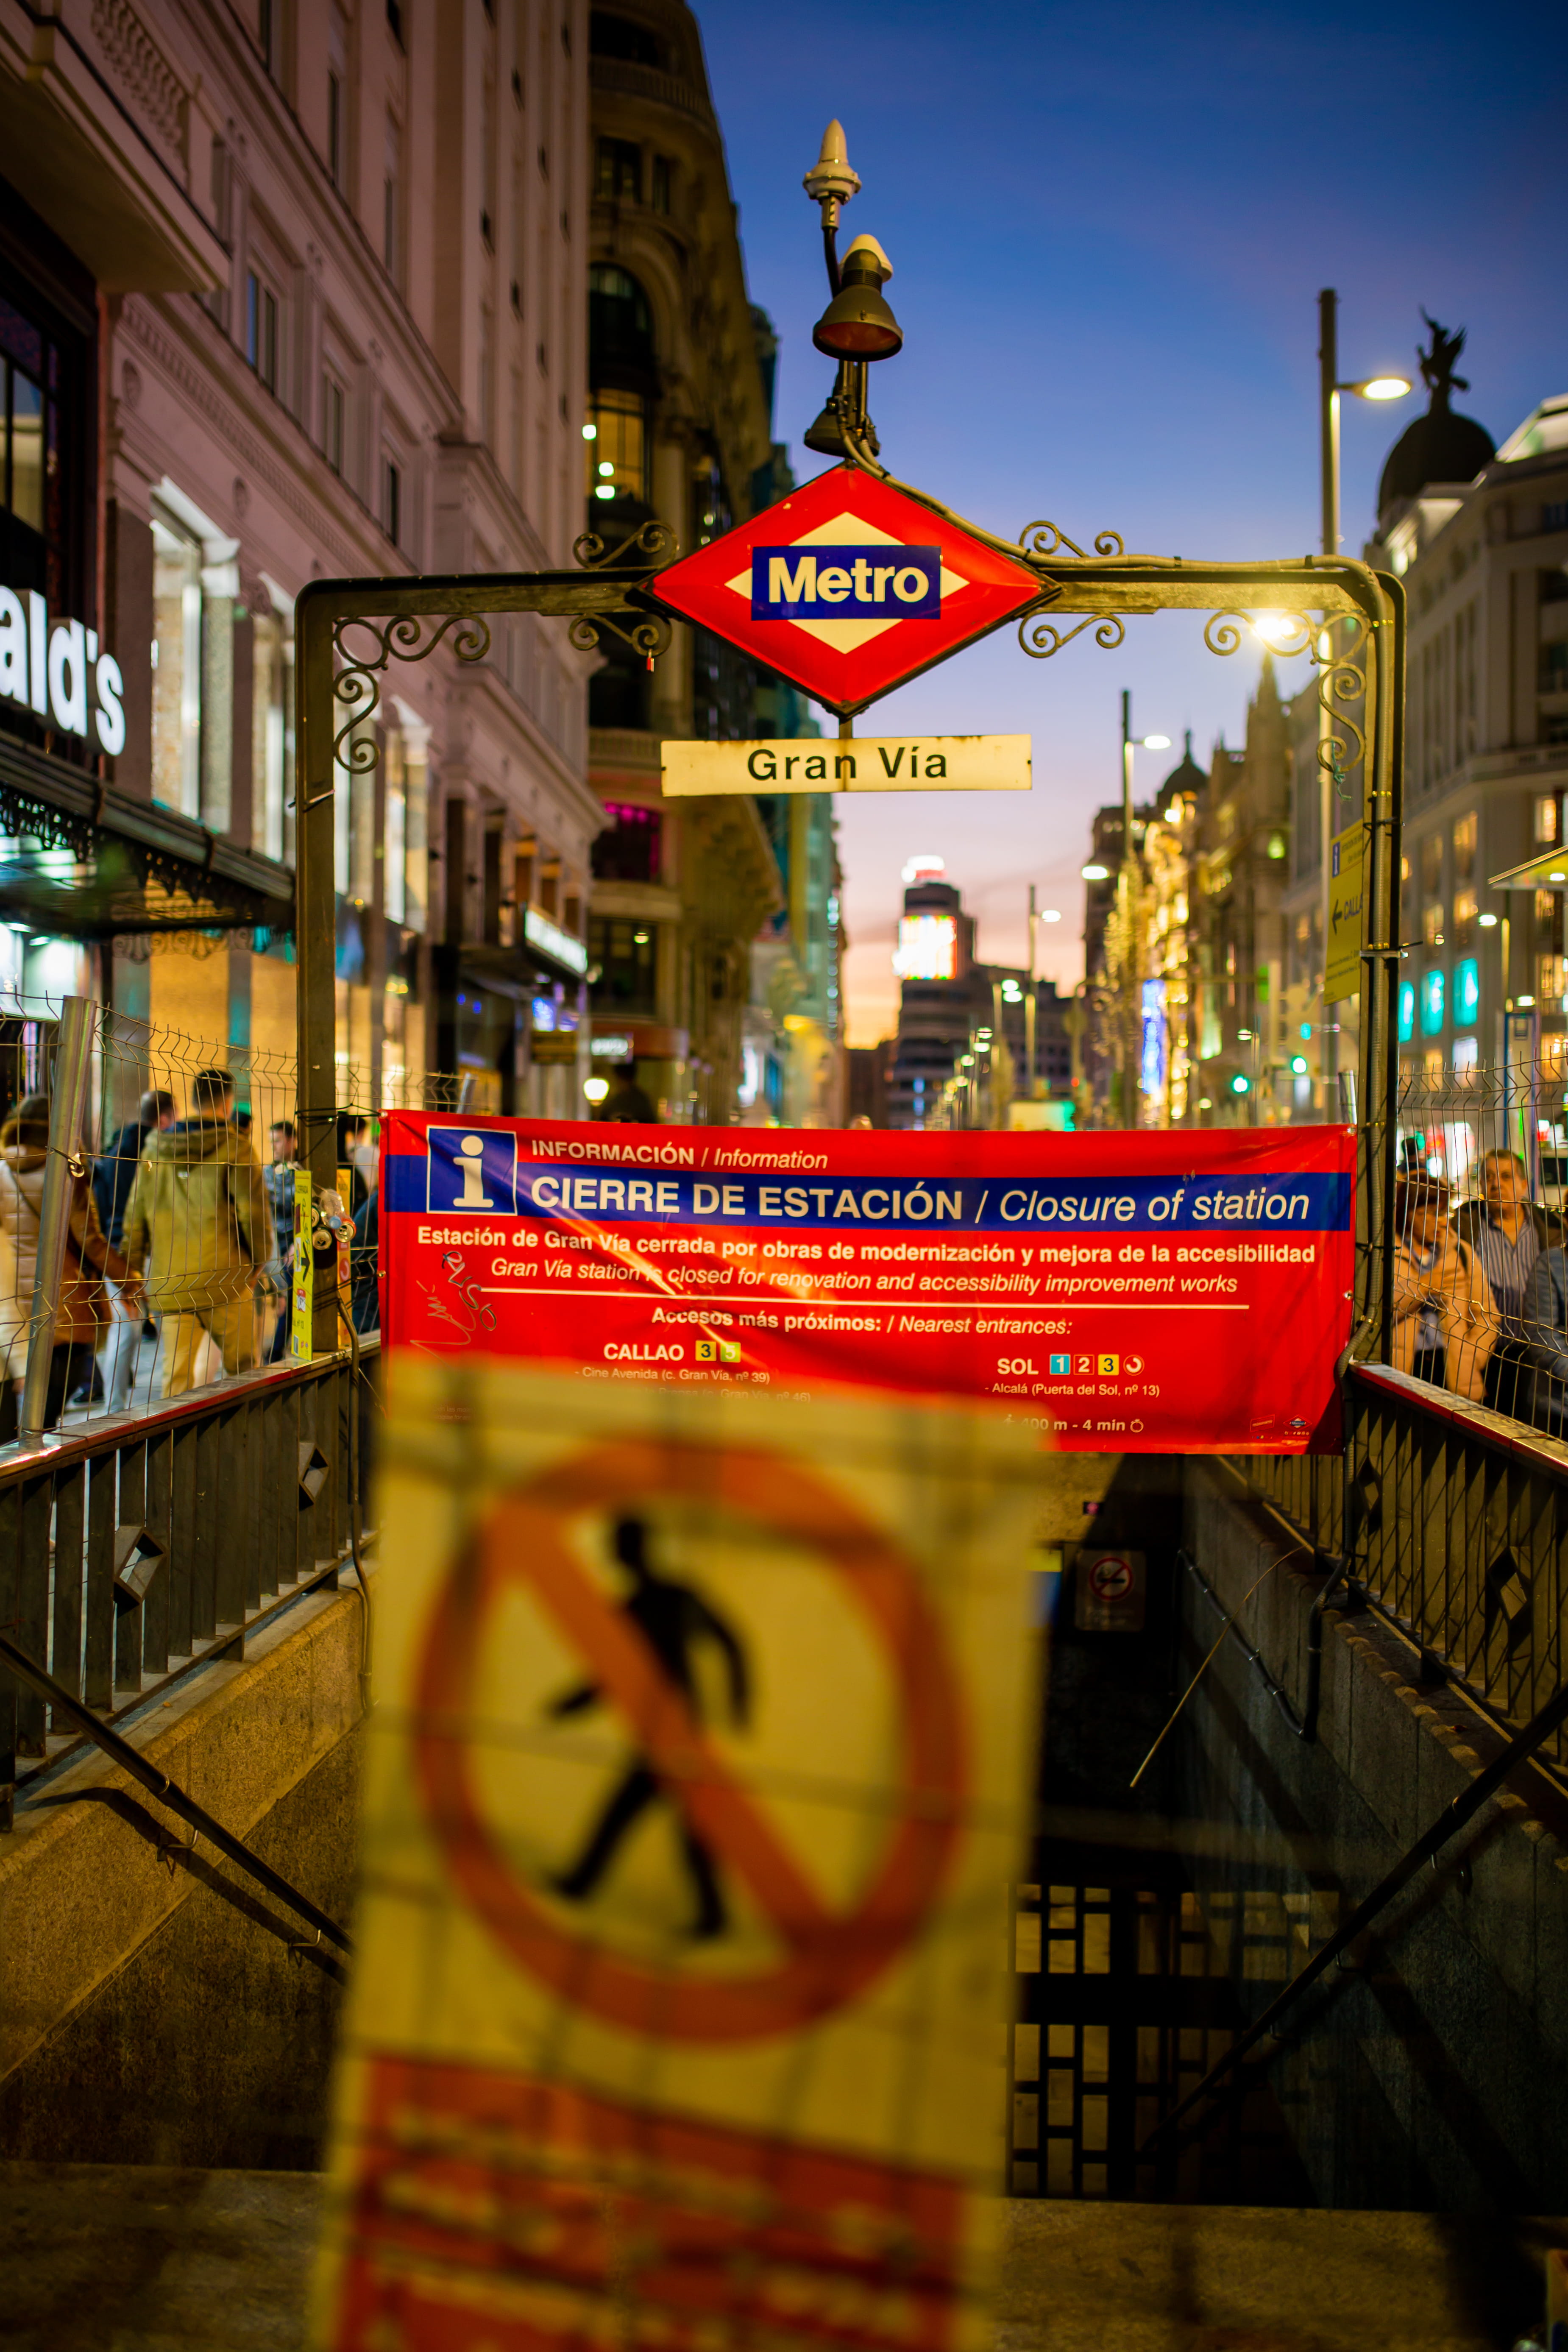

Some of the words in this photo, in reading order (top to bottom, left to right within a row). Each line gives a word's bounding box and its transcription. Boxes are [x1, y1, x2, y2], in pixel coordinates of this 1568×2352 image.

[769, 556, 929, 603] Metro
[748, 749, 857, 781] Gran
[878, 746, 947, 779] Vía
[532, 1140, 694, 1165] INFORMACIÓN
[702, 1147, 709, 1167] /
[714, 1148, 828, 1169] Information
[531, 1176, 680, 1213] CIERRE
[693, 1184, 745, 1215] DE
[759, 1182, 962, 1220] ESTACIÓN
[975, 1190, 989, 1223] /
[1000, 1190, 1136, 1222] Closure
[1148, 1189, 1185, 1221] of
[1192, 1187, 1310, 1220] station
[418, 1226, 506, 1247] Estación
[512, 1229, 538, 1247] de
[544, 1231, 593, 1250] Gran
[599, 1234, 630, 1252] Vía
[637, 1235, 715, 1255] cerrada
[722, 1240, 757, 1259] por
[763, 1241, 822, 1260] obras
[828, 1242, 854, 1260] de
[861, 1243, 1015, 1262] modernización
[1021, 1248, 1033, 1267] y
[1039, 1245, 1112, 1267] mejora
[1118, 1245, 1145, 1262] de
[1152, 1245, 1170, 1262] la
[1176, 1244, 1315, 1263] accesibilidad
[491, 1258, 538, 1277] Gran
[544, 1259, 572, 1278] Vía
[577, 1262, 641, 1280] station
[645, 1265, 662, 1282] is
[668, 1266, 733, 1285] closed
[738, 1268, 765, 1285] for
[769, 1271, 871, 1290] renovation
[876, 1273, 915, 1290] and
[919, 1274, 1041, 1296] accessibility
[1045, 1275, 1175, 1296] improvement
[1181, 1274, 1237, 1293] works
[652, 1307, 734, 1326] Accesos
[739, 1310, 778, 1328] más
[785, 1313, 881, 1332] próximos:
[886, 1315, 894, 1333] /
[899, 1316, 970, 1333] Nearest
[976, 1318, 1073, 1335] entrances:
[604, 1343, 684, 1361] CALLAO
[701, 1344, 711, 1358] 3
[725, 1345, 736, 1360] 5
[997, 1357, 1039, 1375] SOL
[1078, 1357, 1090, 1373] 2
[1103, 1358, 1114, 1372] 3
[582, 1366, 609, 1378] Cine
[611, 1368, 658, 1380] Avenida
[661, 1370, 676, 1382] (c.
[679, 1370, 708, 1380] Gran
[710, 1370, 733, 1382] Vía,
[751, 1372, 771, 1385] 39)
[992, 1382, 1028, 1394] Alcalá
[1032, 1383, 1074, 1396] (Puerta
[1077, 1384, 1095, 1395] del
[1099, 1384, 1121, 1396] Sol,
[1142, 1385, 1160, 1398] 13)
[1053, 1420, 1068, 1431] m
[1082, 1419, 1092, 1431] 4
[1097, 1418, 1126, 1431] min
